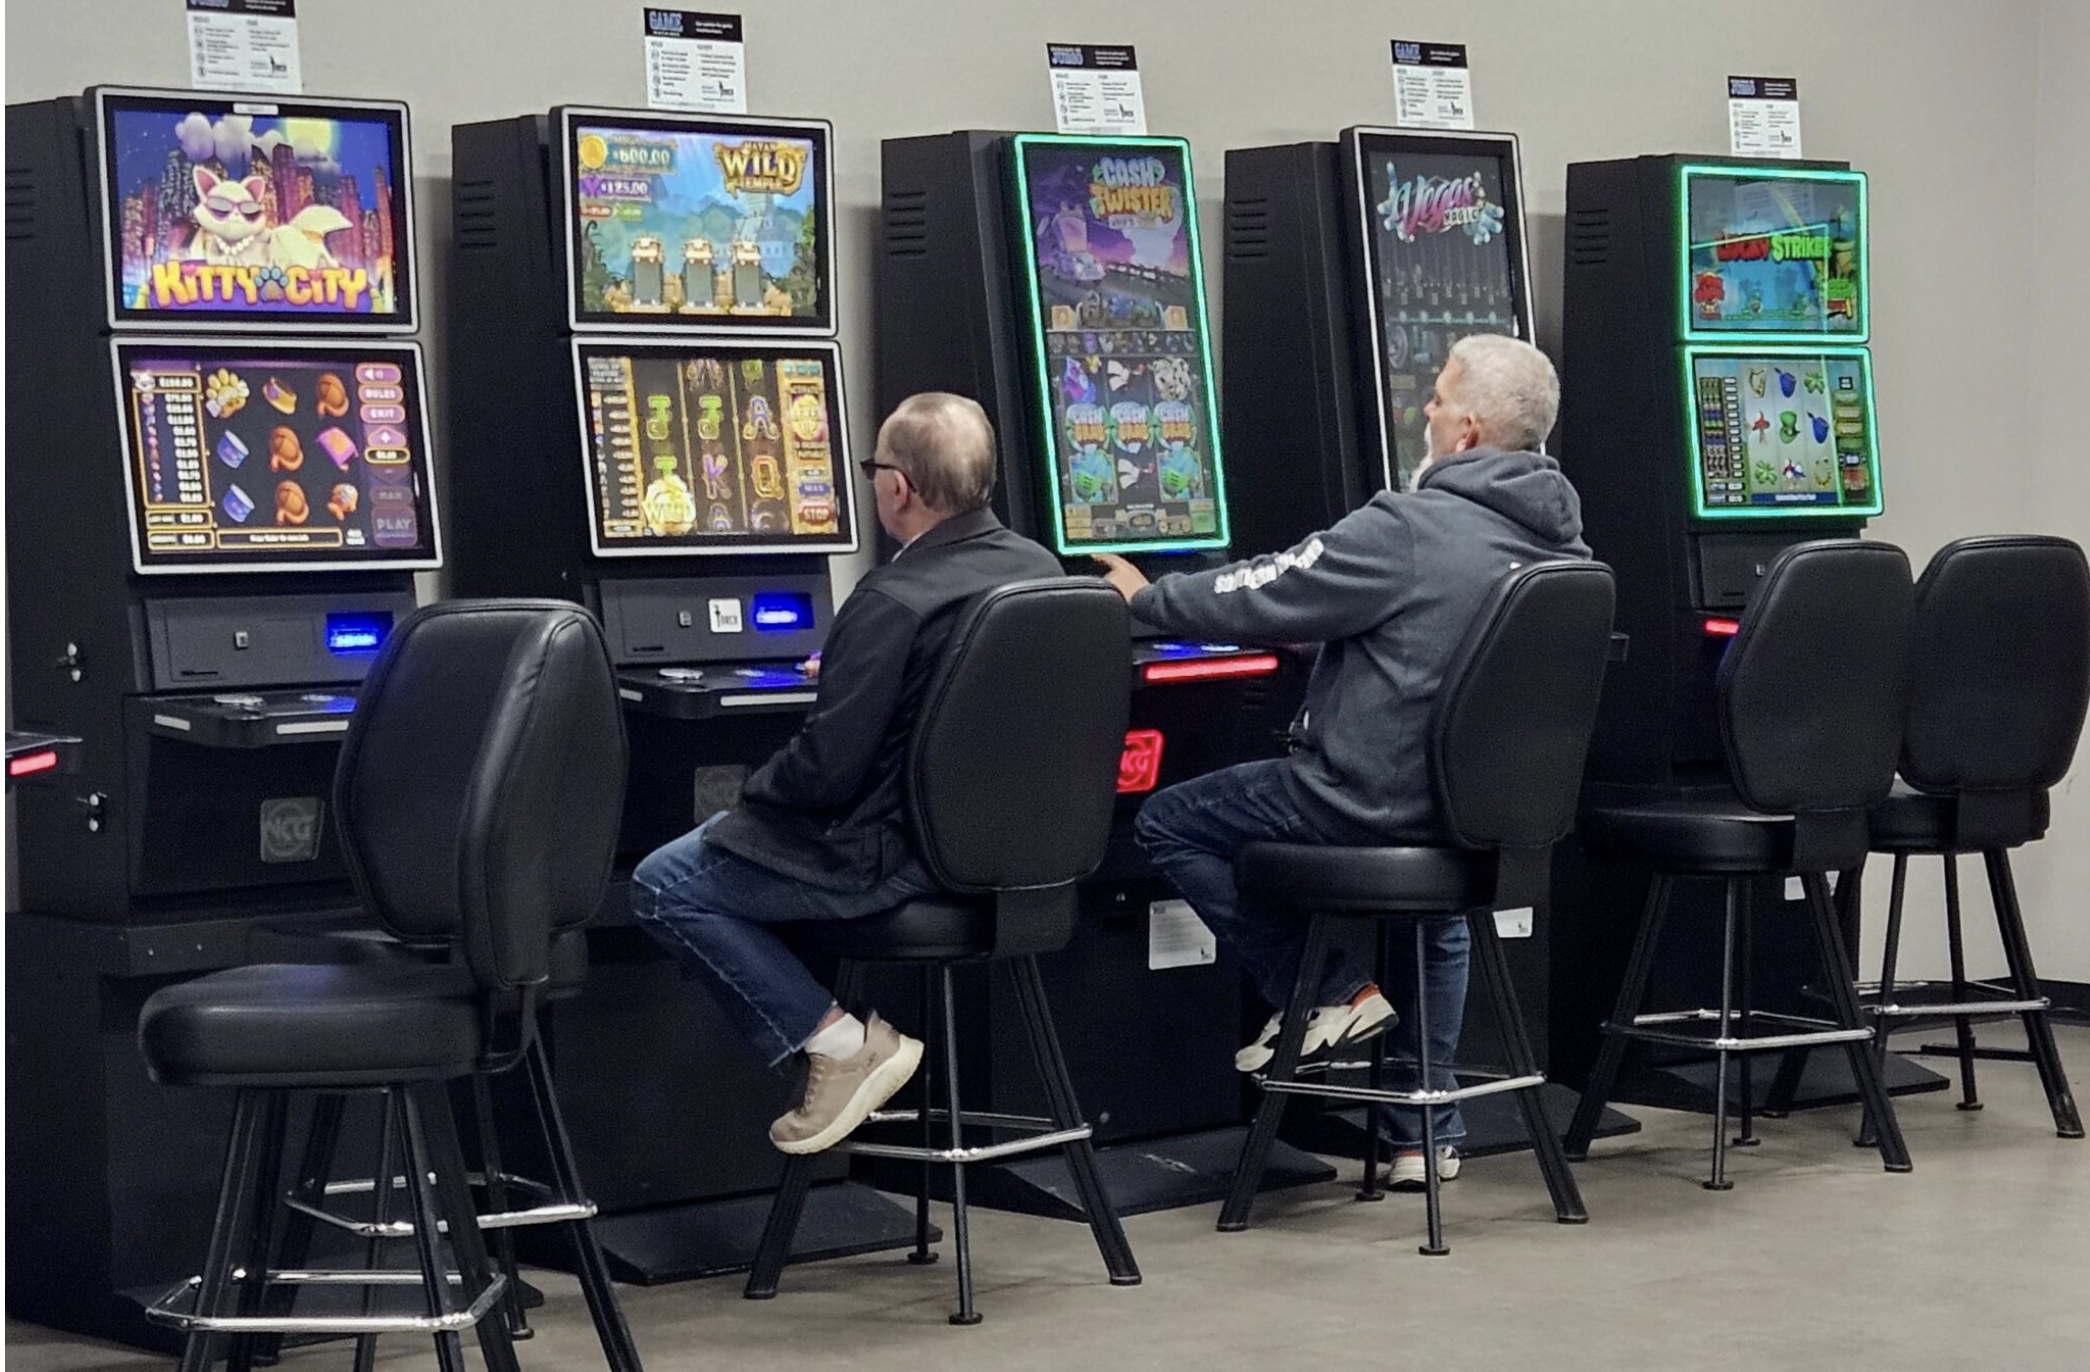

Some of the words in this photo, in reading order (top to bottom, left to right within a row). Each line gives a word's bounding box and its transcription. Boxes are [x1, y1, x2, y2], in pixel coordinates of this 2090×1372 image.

[721, 149, 796, 183] WILD
[1100, 157, 1156, 188] CASH
[1089, 183, 1173, 219] TWISTER
[1443, 208, 1479, 225] MAGIC
[376, 518, 411, 531] PLAY
